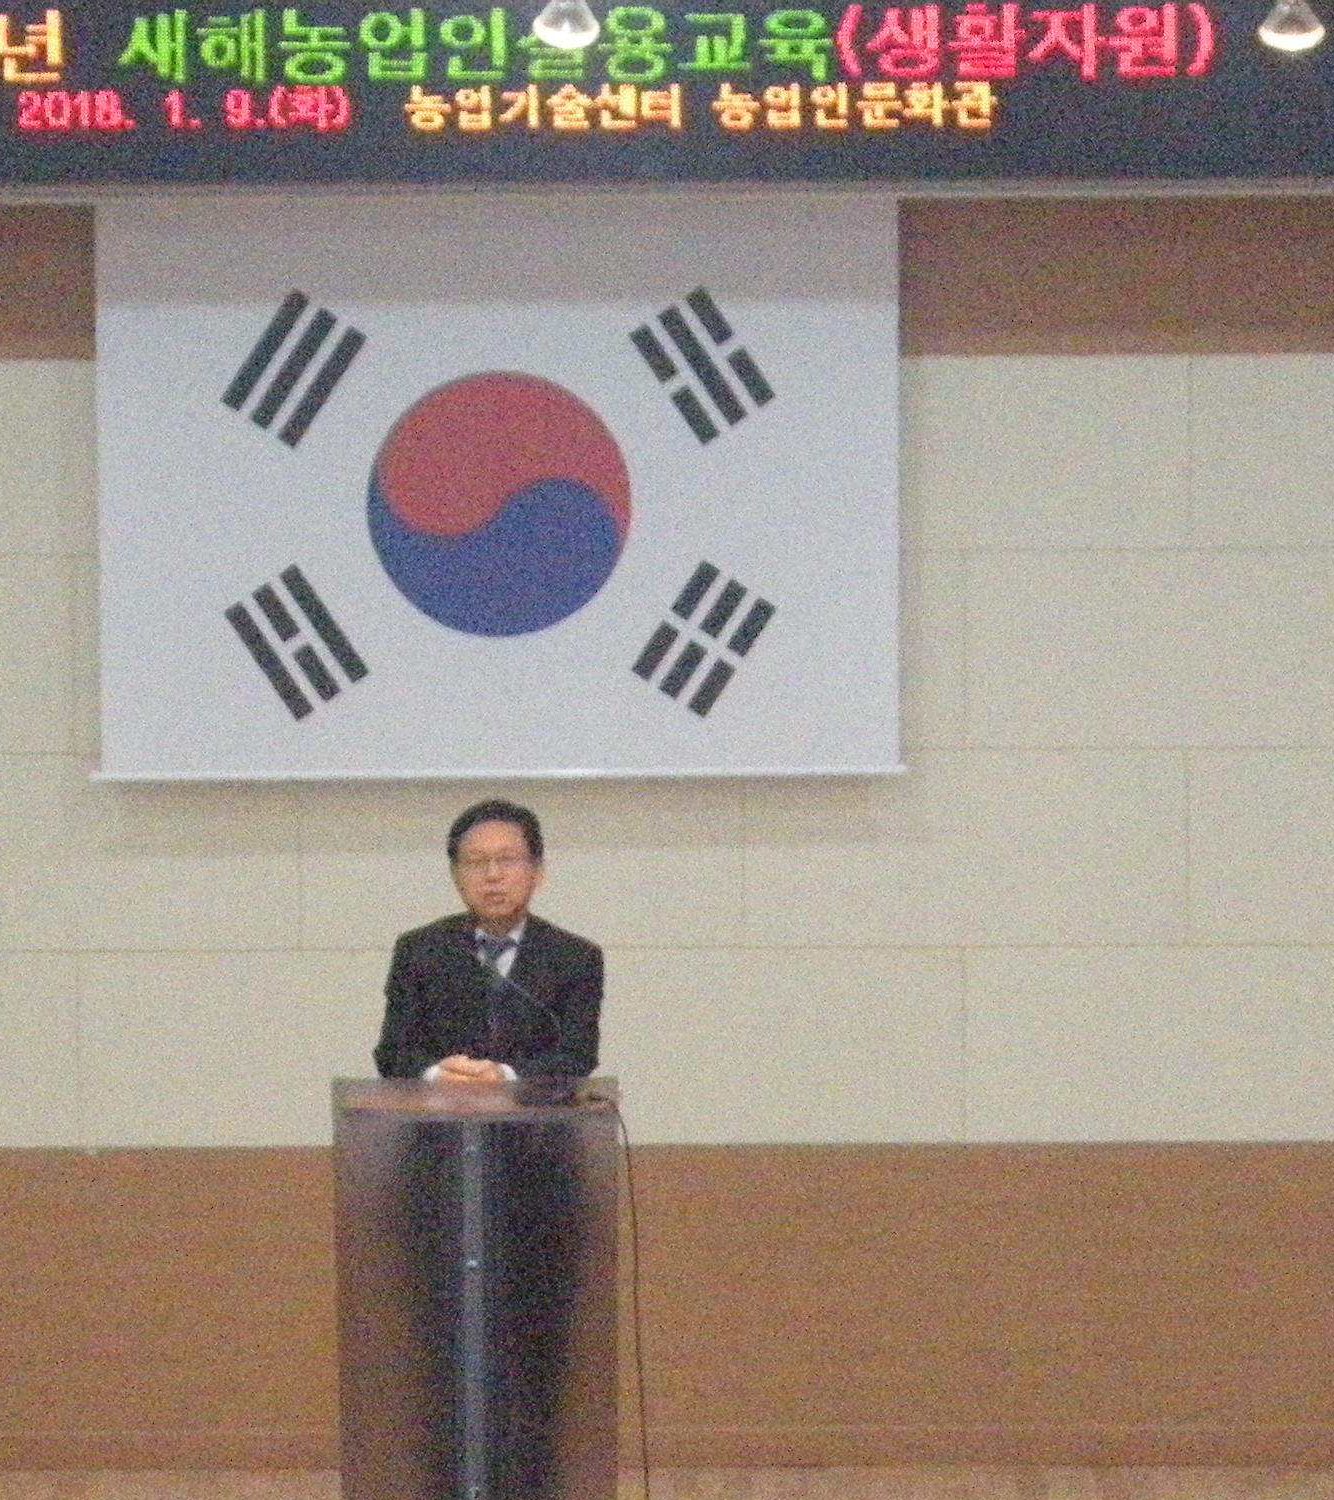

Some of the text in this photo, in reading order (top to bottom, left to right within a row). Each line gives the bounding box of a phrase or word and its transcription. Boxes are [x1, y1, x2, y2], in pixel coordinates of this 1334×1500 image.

[17, 88, 136, 130] 2018.
[165, 89, 203, 129] 1.
[404, 83, 683, 132] 농업기술센터
[712, 80, 998, 130] 농업인문화관
